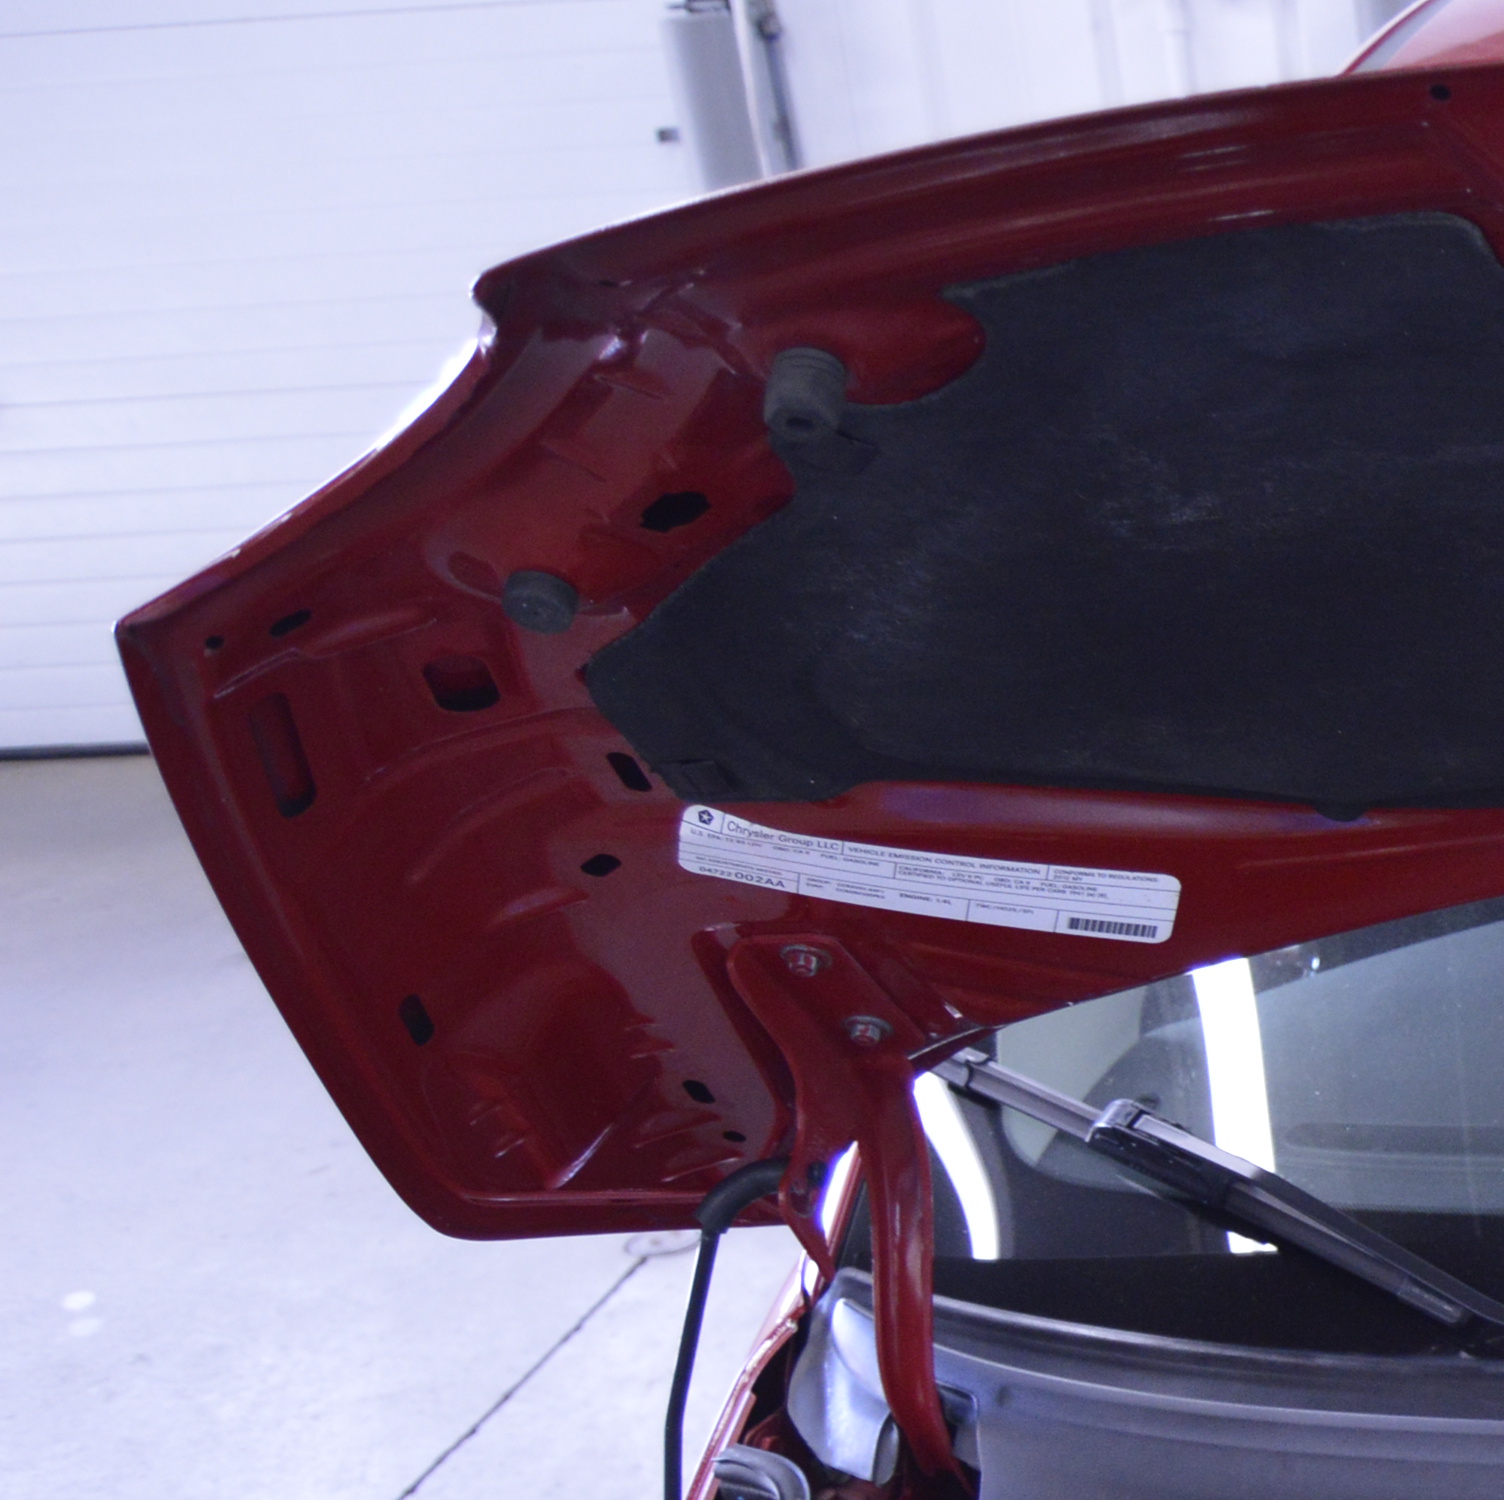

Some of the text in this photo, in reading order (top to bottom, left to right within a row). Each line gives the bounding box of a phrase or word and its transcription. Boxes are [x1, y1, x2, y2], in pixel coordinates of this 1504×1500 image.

[727, 820, 774, 840] Chrysler
[778, 834, 814, 847] Group
[817, 841, 839, 851] LLC
[848, 846, 1041, 875] VEHICLE EMISSION CONTROL INFORMATION
